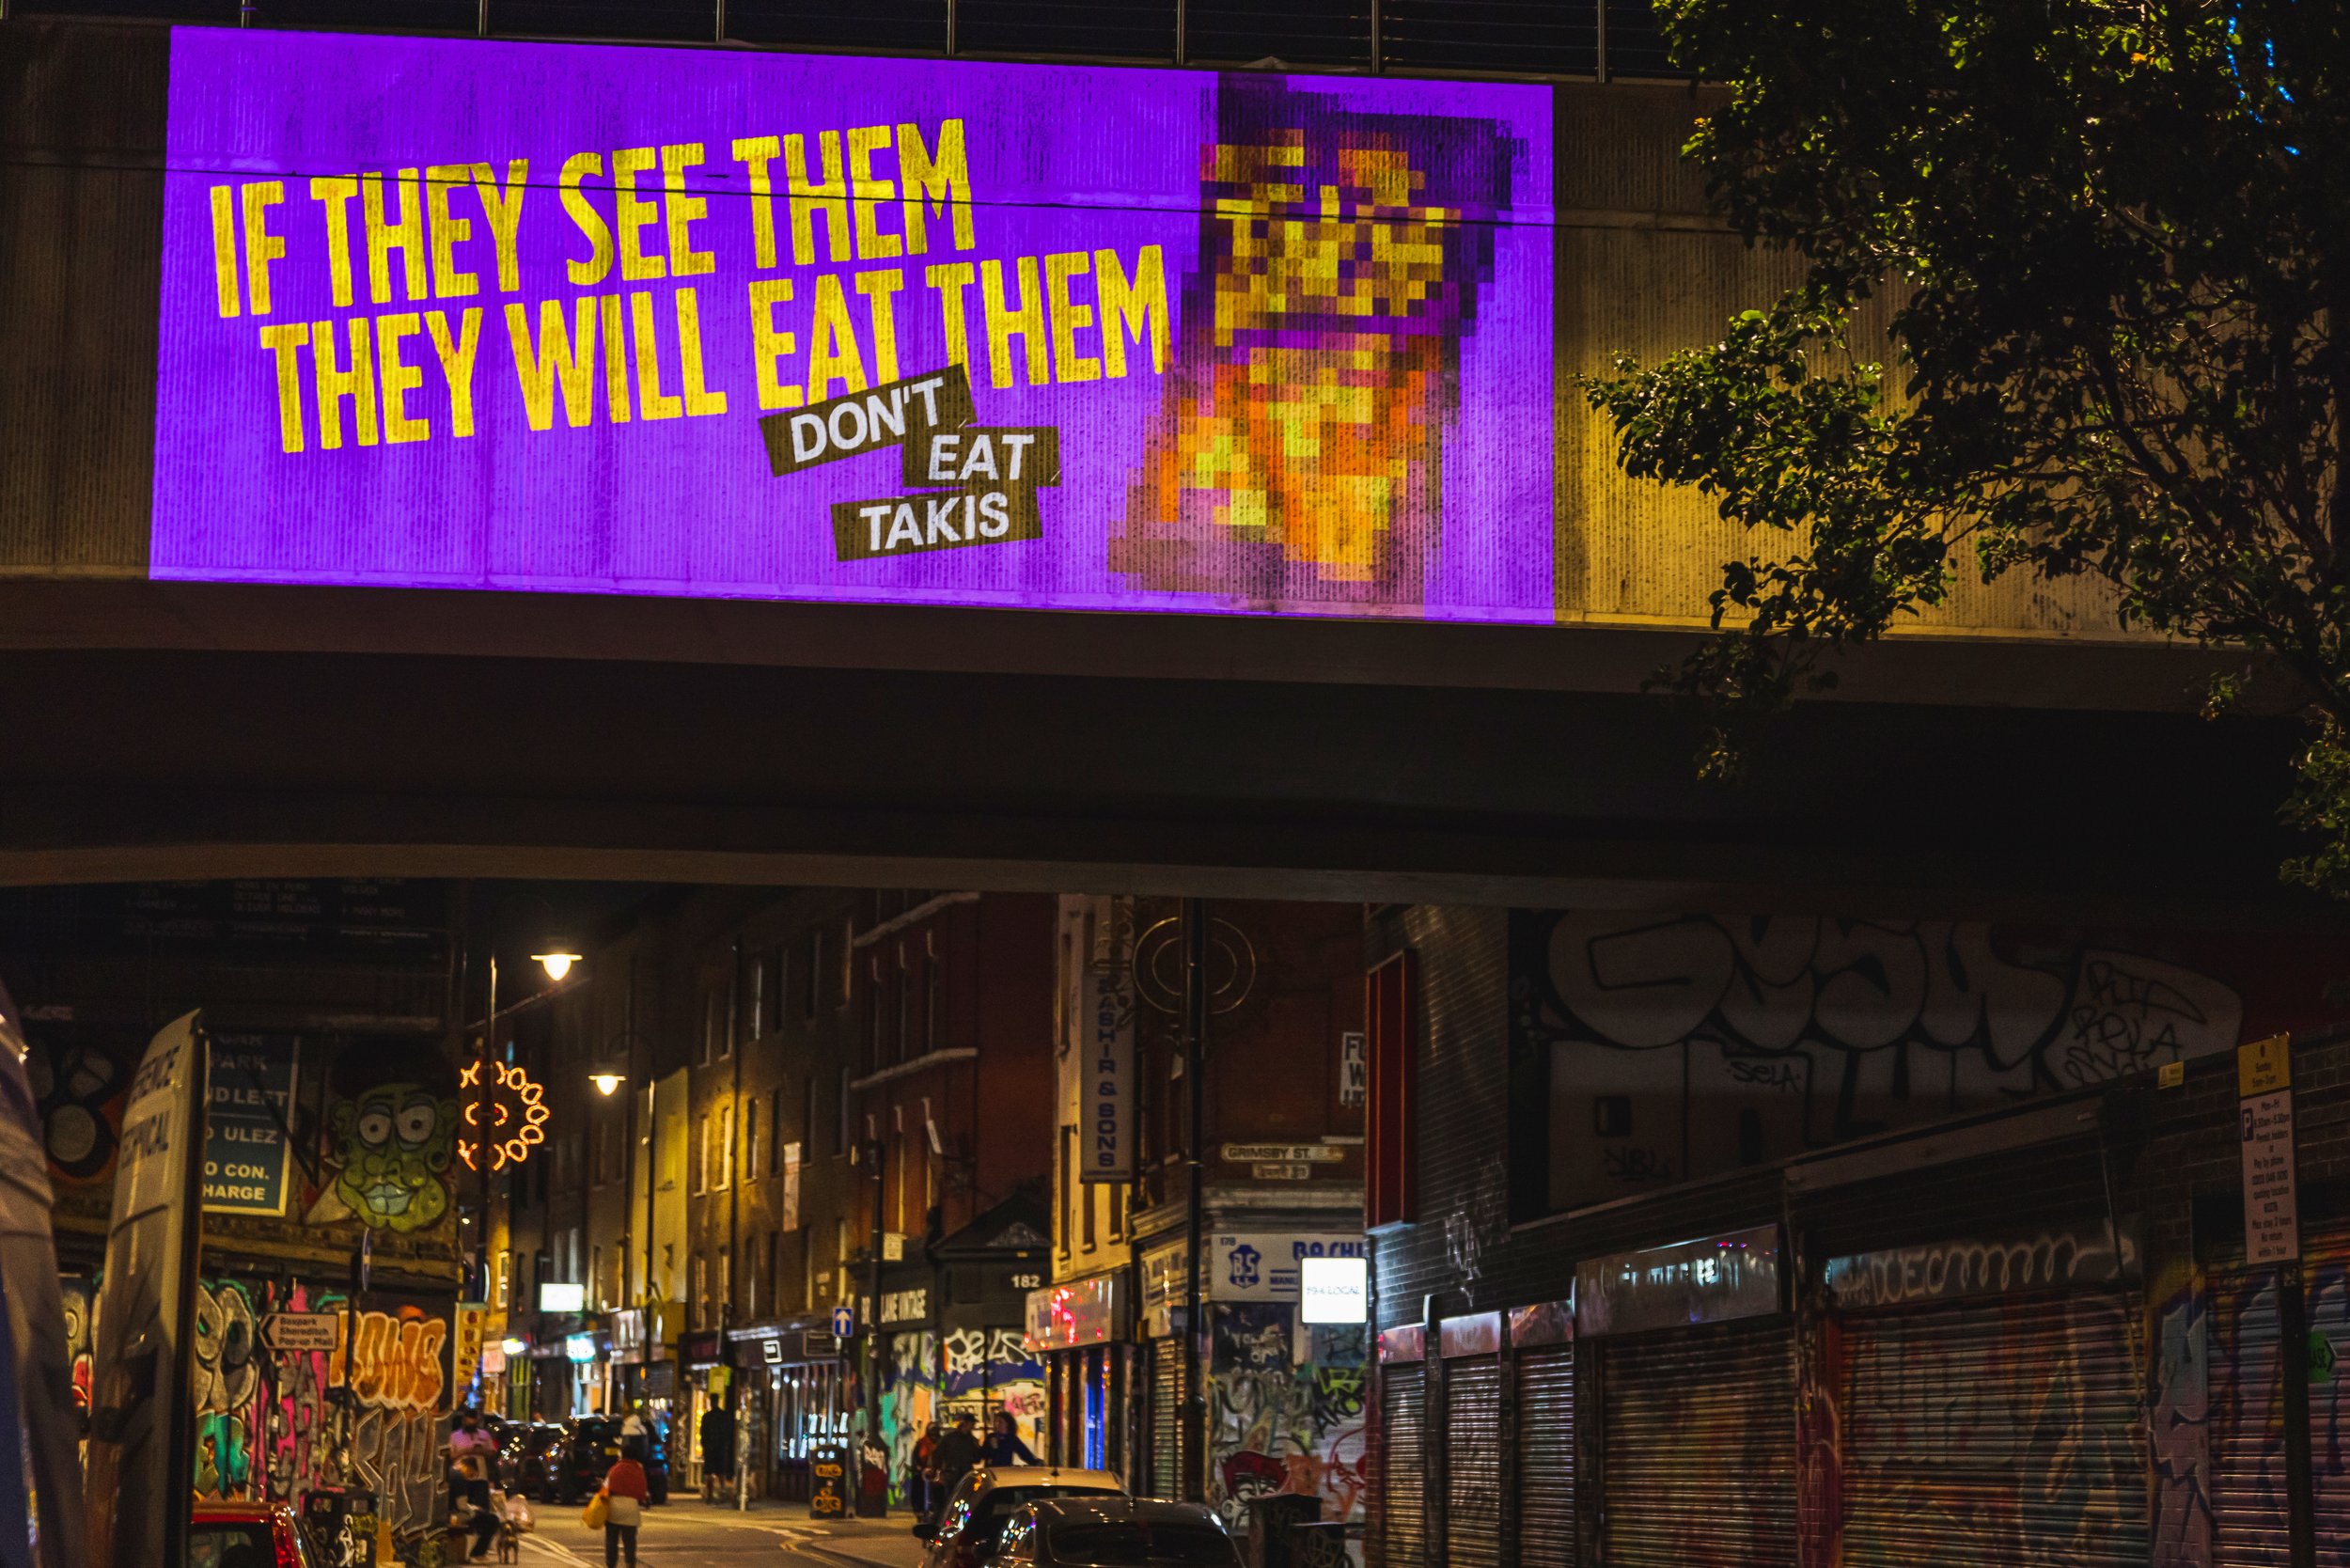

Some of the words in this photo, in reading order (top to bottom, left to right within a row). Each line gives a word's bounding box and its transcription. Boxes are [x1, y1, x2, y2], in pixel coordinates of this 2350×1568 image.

[210, 180, 286, 318] IF
[310, 158, 529, 307] THEY
[559, 142, 716, 286] SEE
[731, 118, 976, 270] THEM
[259, 306, 484, 453] THEY
[504, 286, 728, 431] WILL
[748, 268, 904, 411] EAT
[925, 243, 1173, 390] THEM
[790, 376, 944, 463] DON'T
[928, 433, 1036, 481] EAT
[858, 492, 1010, 552] TAKIS
[1098, 1081, 1117, 1096] &
[225, 1126, 278, 1144] ULEZ
[1097, 1103, 1117, 1168] SONS
[2243, 1112, 2252, 1138] P
[1228, 1147, 1290, 1159] GRIMSBY
[225, 1163, 271, 1180] CON.
[203, 1183, 266, 1201] HARGE
[1010, 1267, 1040, 1288] 182
